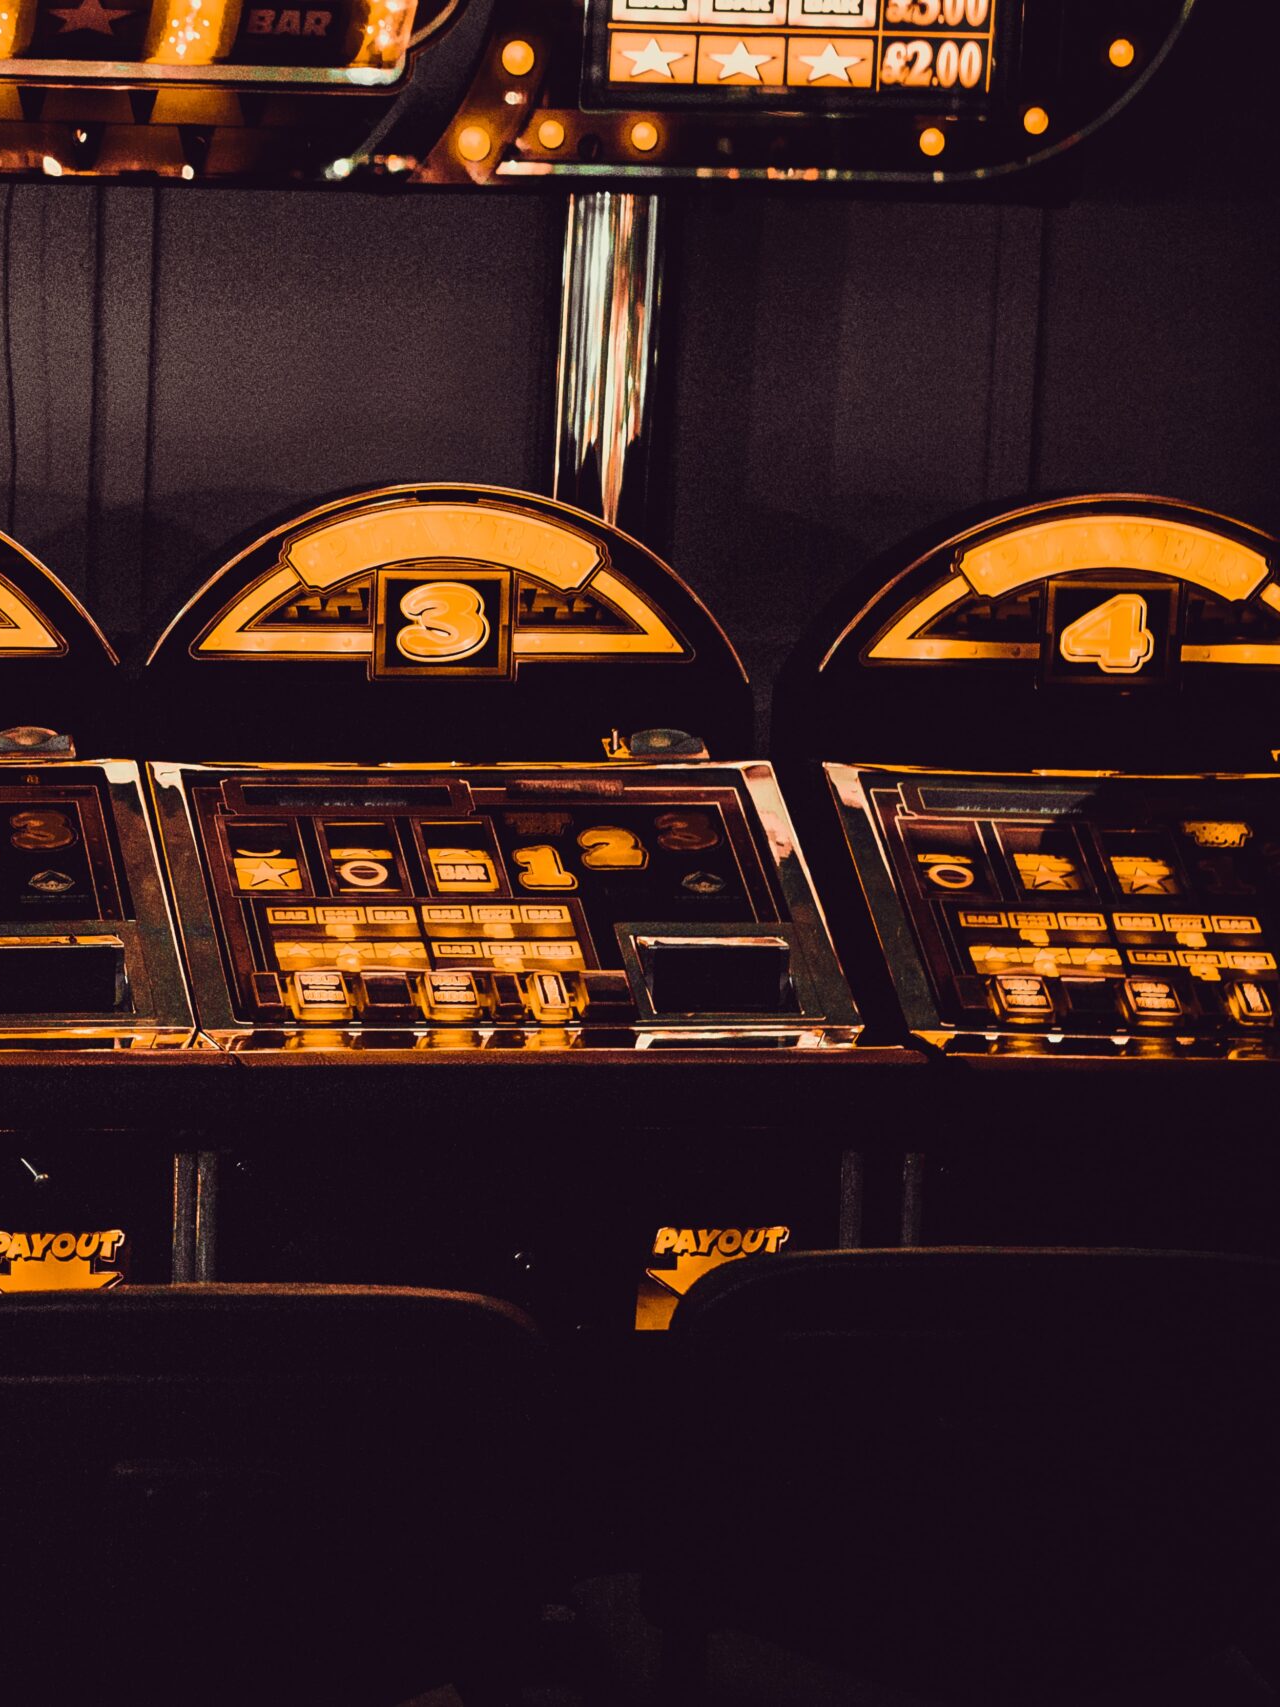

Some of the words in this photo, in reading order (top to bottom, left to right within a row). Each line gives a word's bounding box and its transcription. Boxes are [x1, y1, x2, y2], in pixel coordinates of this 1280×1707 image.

[247, 8, 332, 37] BAR
[881, 39, 982, 89] £2.00
[327, 512, 569, 576] PLAYER
[396, 581, 490, 662] 3
[1061, 593, 1154, 673] 4
[11, 811, 78, 851] 3
[577, 825, 650, 871] 2
[654, 812, 723, 851] 3
[435, 863, 488, 881] BAR
[511, 844, 578, 891] 1
[273, 911, 308, 920] BAR
[374, 911, 407, 920] BAR
[429, 910, 463, 919] BAR
[529, 910, 562, 919] BAR
[654, 1226, 788, 1256] PAYOUT
